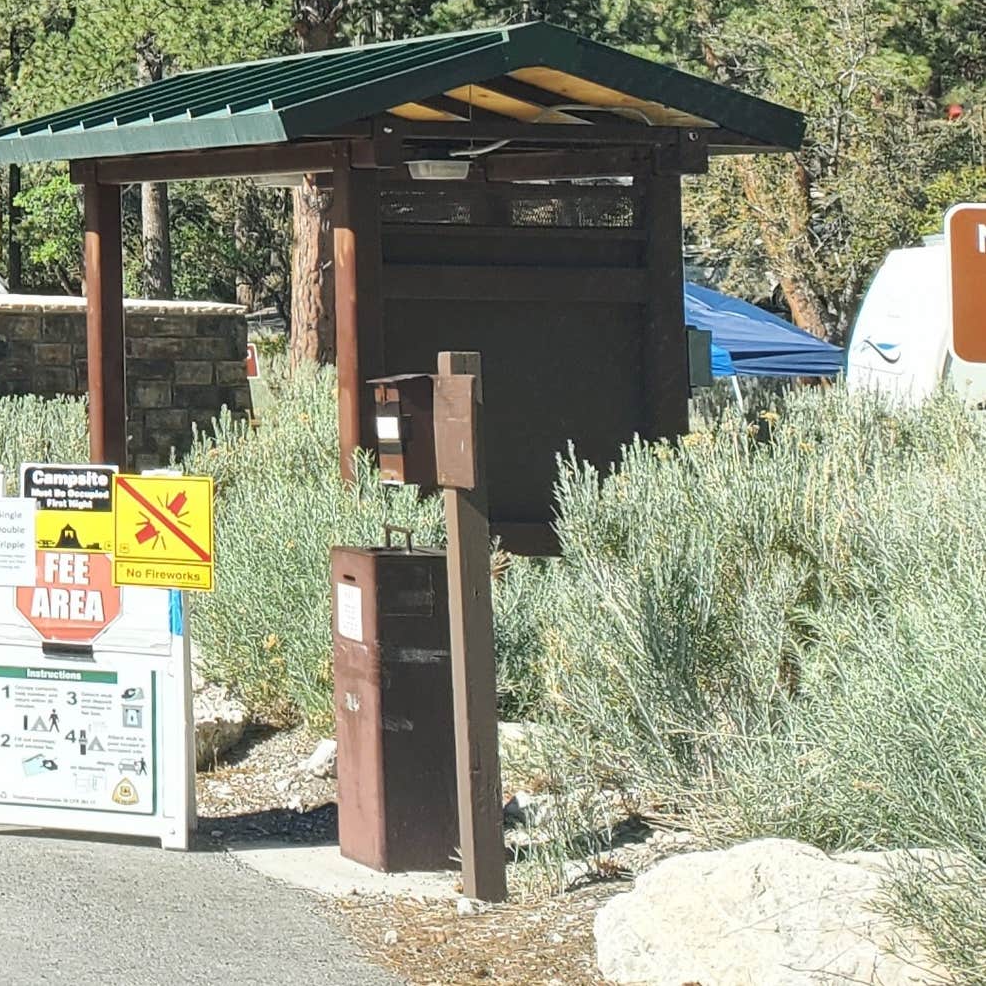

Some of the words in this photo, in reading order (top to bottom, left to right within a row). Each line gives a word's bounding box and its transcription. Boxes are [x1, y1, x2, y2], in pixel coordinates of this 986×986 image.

[32, 470, 109, 488] Campsite
[31, 488, 52, 497] Must
[54, 489, 66, 498] Be
[67, 489, 109, 500] Occupied
[46, 499, 67, 508] First
[68, 499, 93, 510] Night
[45, 553, 90, 585] FEE
[126, 568, 142, 578] No
[145, 569, 201, 581] Fireworks
[31, 588, 105, 622] AREA
[27, 668, 82, 680] Instructions
[2, 685, 10, 699] 1
[66, 692, 77, 705] 3
[0, 734, 11, 747] 2
[65, 730, 76, 743] 4
